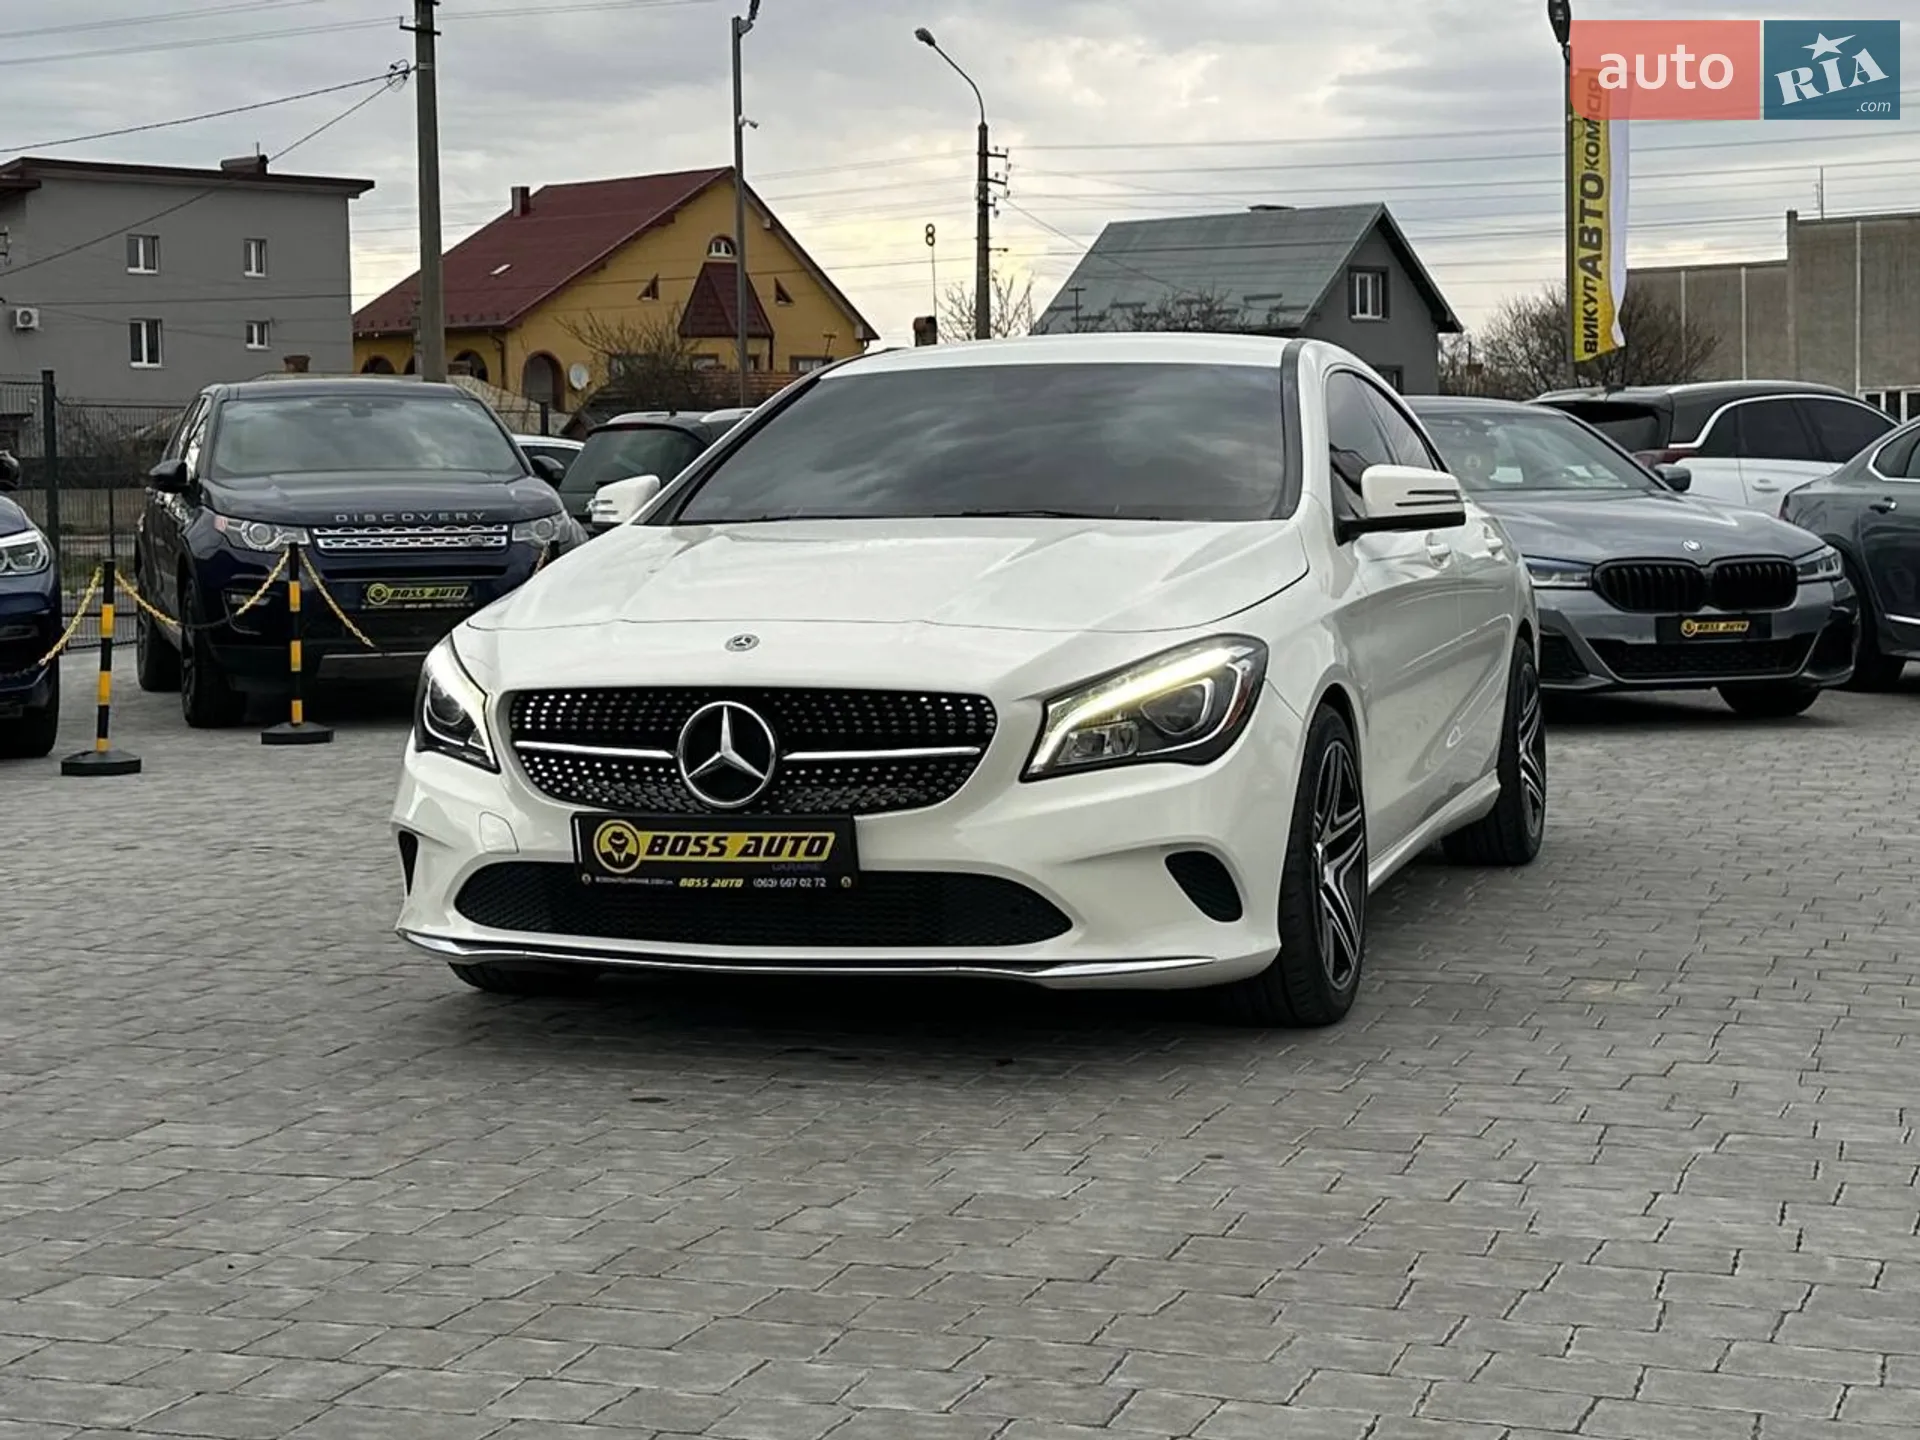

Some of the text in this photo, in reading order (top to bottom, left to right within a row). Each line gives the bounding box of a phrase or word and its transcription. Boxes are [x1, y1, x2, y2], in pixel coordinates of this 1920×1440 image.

[1578, 173, 1604, 281] АВТО
[1583, 278, 1599, 354] ВИКУП
[335, 511, 487, 523] DISCOVERY
[645, 834, 830, 858] BOSS AUTO
[679, 877, 709, 888] BOSS
[711, 877, 744, 888] AUTO
[799, 877, 813, 888] 02
[814, 877, 827, 888] 72
